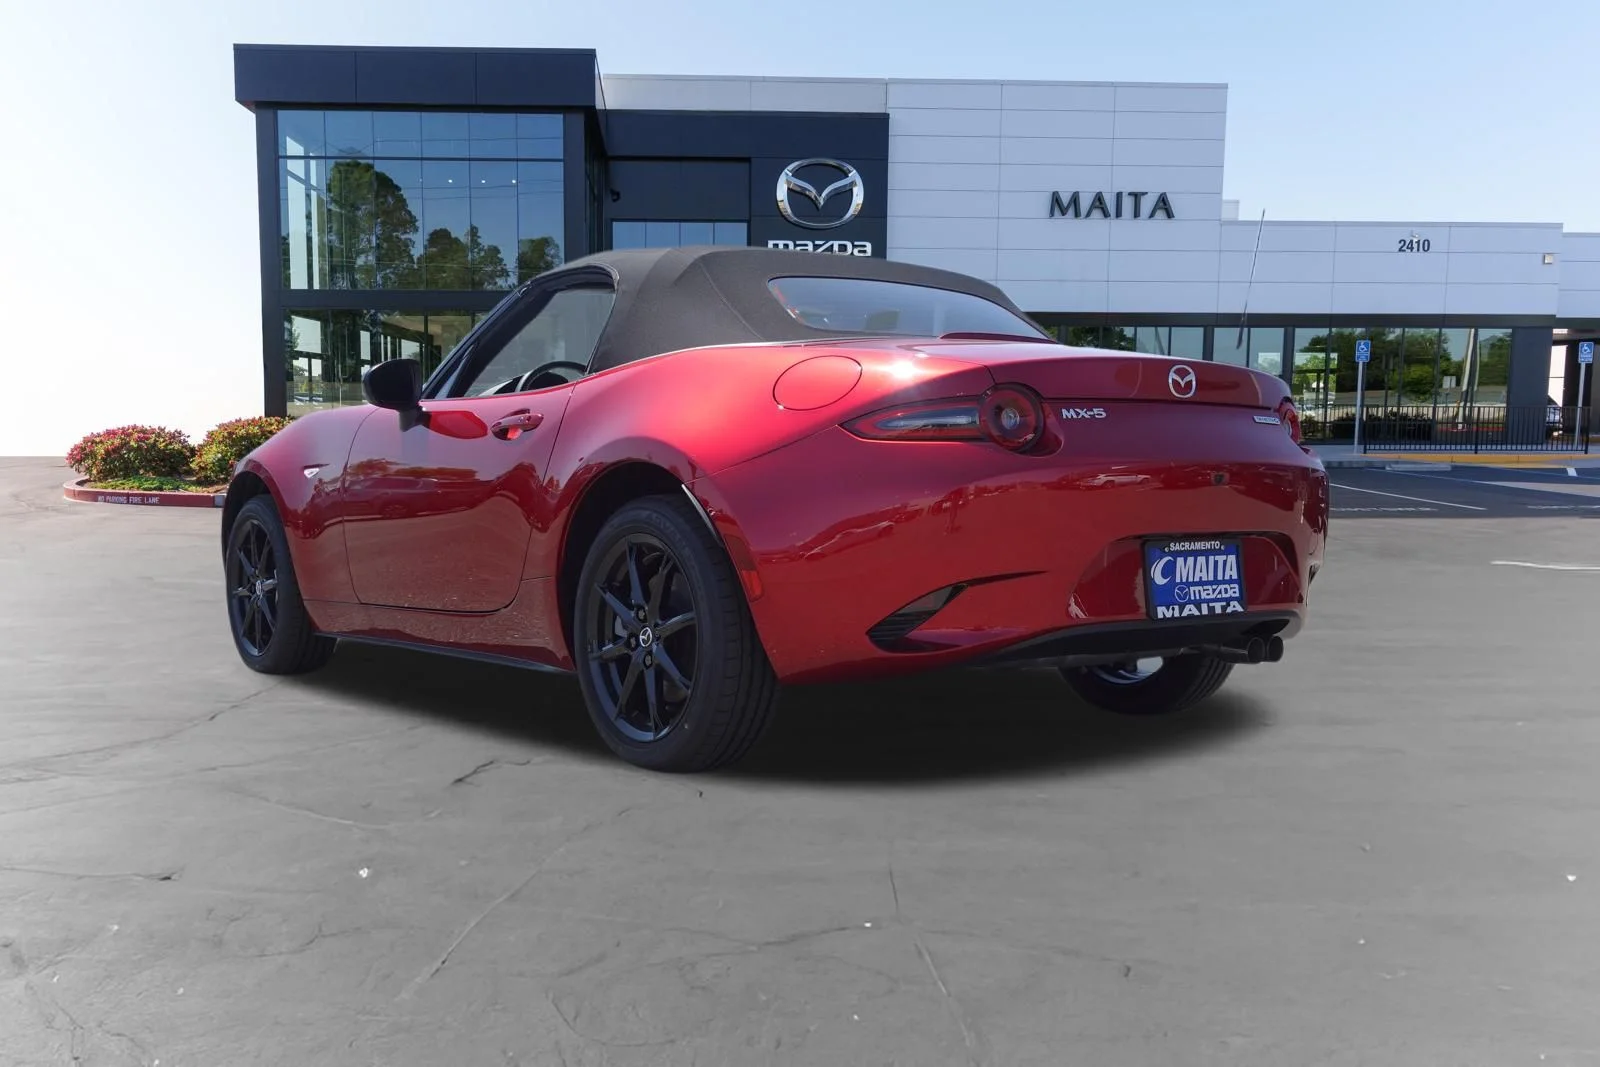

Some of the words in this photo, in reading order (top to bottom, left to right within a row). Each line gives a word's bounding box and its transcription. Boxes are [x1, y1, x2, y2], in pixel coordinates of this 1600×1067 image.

[1049, 190, 1175, 219] MAITA
[1398, 239, 1430, 252] 2410
[1061, 407, 1107, 420] MX-5
[106, 496, 127, 504] PARKING
[129, 496, 142, 504] FIRE
[145, 496, 160, 504] LANE
[1169, 541, 1220, 552] SACRAMENTO
[1175, 555, 1238, 583] MAITA
[1156, 601, 1244, 619] MAITA
